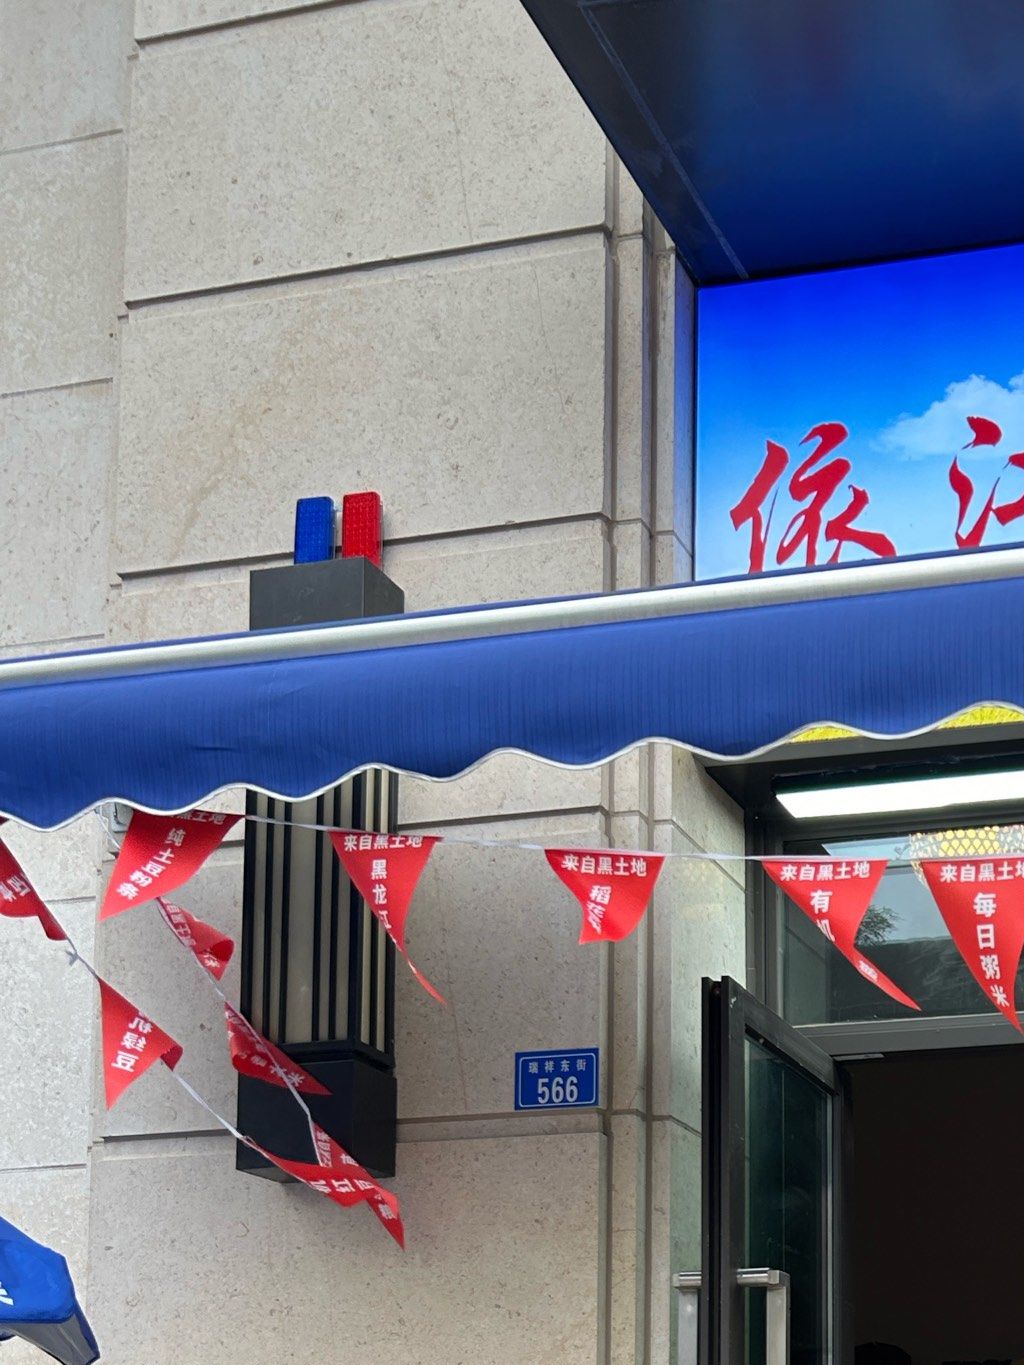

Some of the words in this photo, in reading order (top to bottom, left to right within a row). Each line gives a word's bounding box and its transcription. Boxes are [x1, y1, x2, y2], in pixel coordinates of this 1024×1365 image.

[344, 835, 423, 851] 来自黑土地
[116, 828, 186, 901] 纯土豆粉条
[562, 855, 647, 877] 来自黑土地
[780, 861, 871, 881] 来自黑土地
[973, 893, 1010, 1008] 每日粥米
[529, 1059, 587, 1074] 瑞祥东街
[537, 1077, 579, 1103] 566
